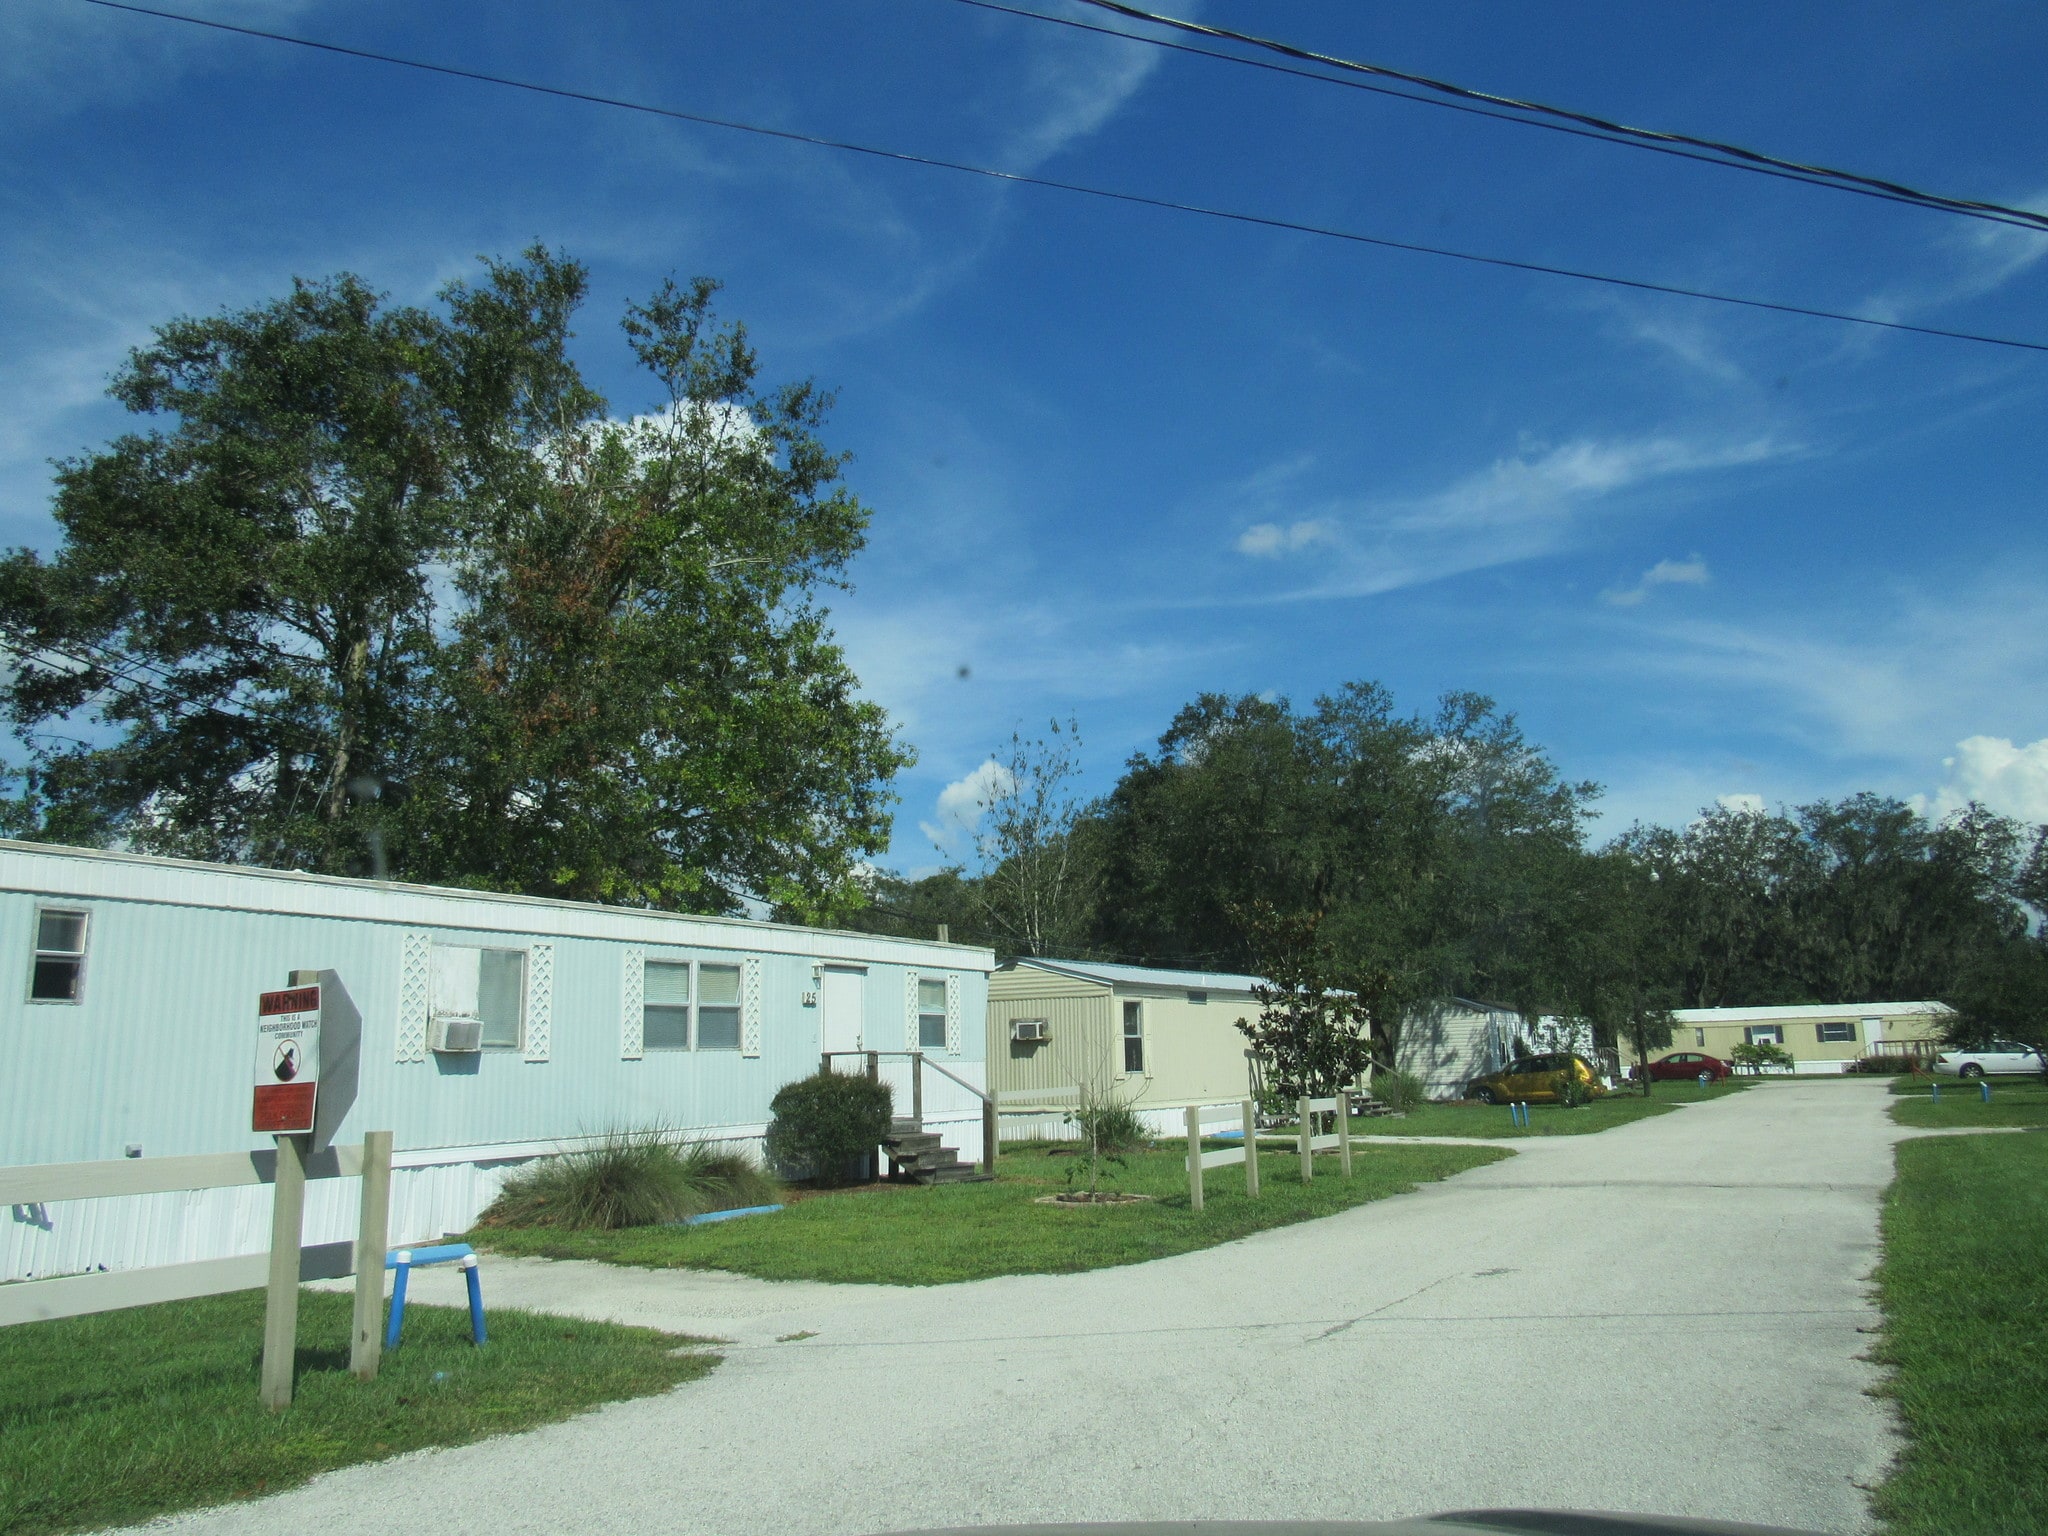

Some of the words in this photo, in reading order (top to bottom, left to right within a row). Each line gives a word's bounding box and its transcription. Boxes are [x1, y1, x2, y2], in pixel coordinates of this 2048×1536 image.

[262, 989, 318, 1013] WARNING
[260, 1021, 301, 1032] NEIGHBORHOOD
[302, 1019, 318, 1029] WATCH
[275, 1030, 303, 1039] COMMUNITY
